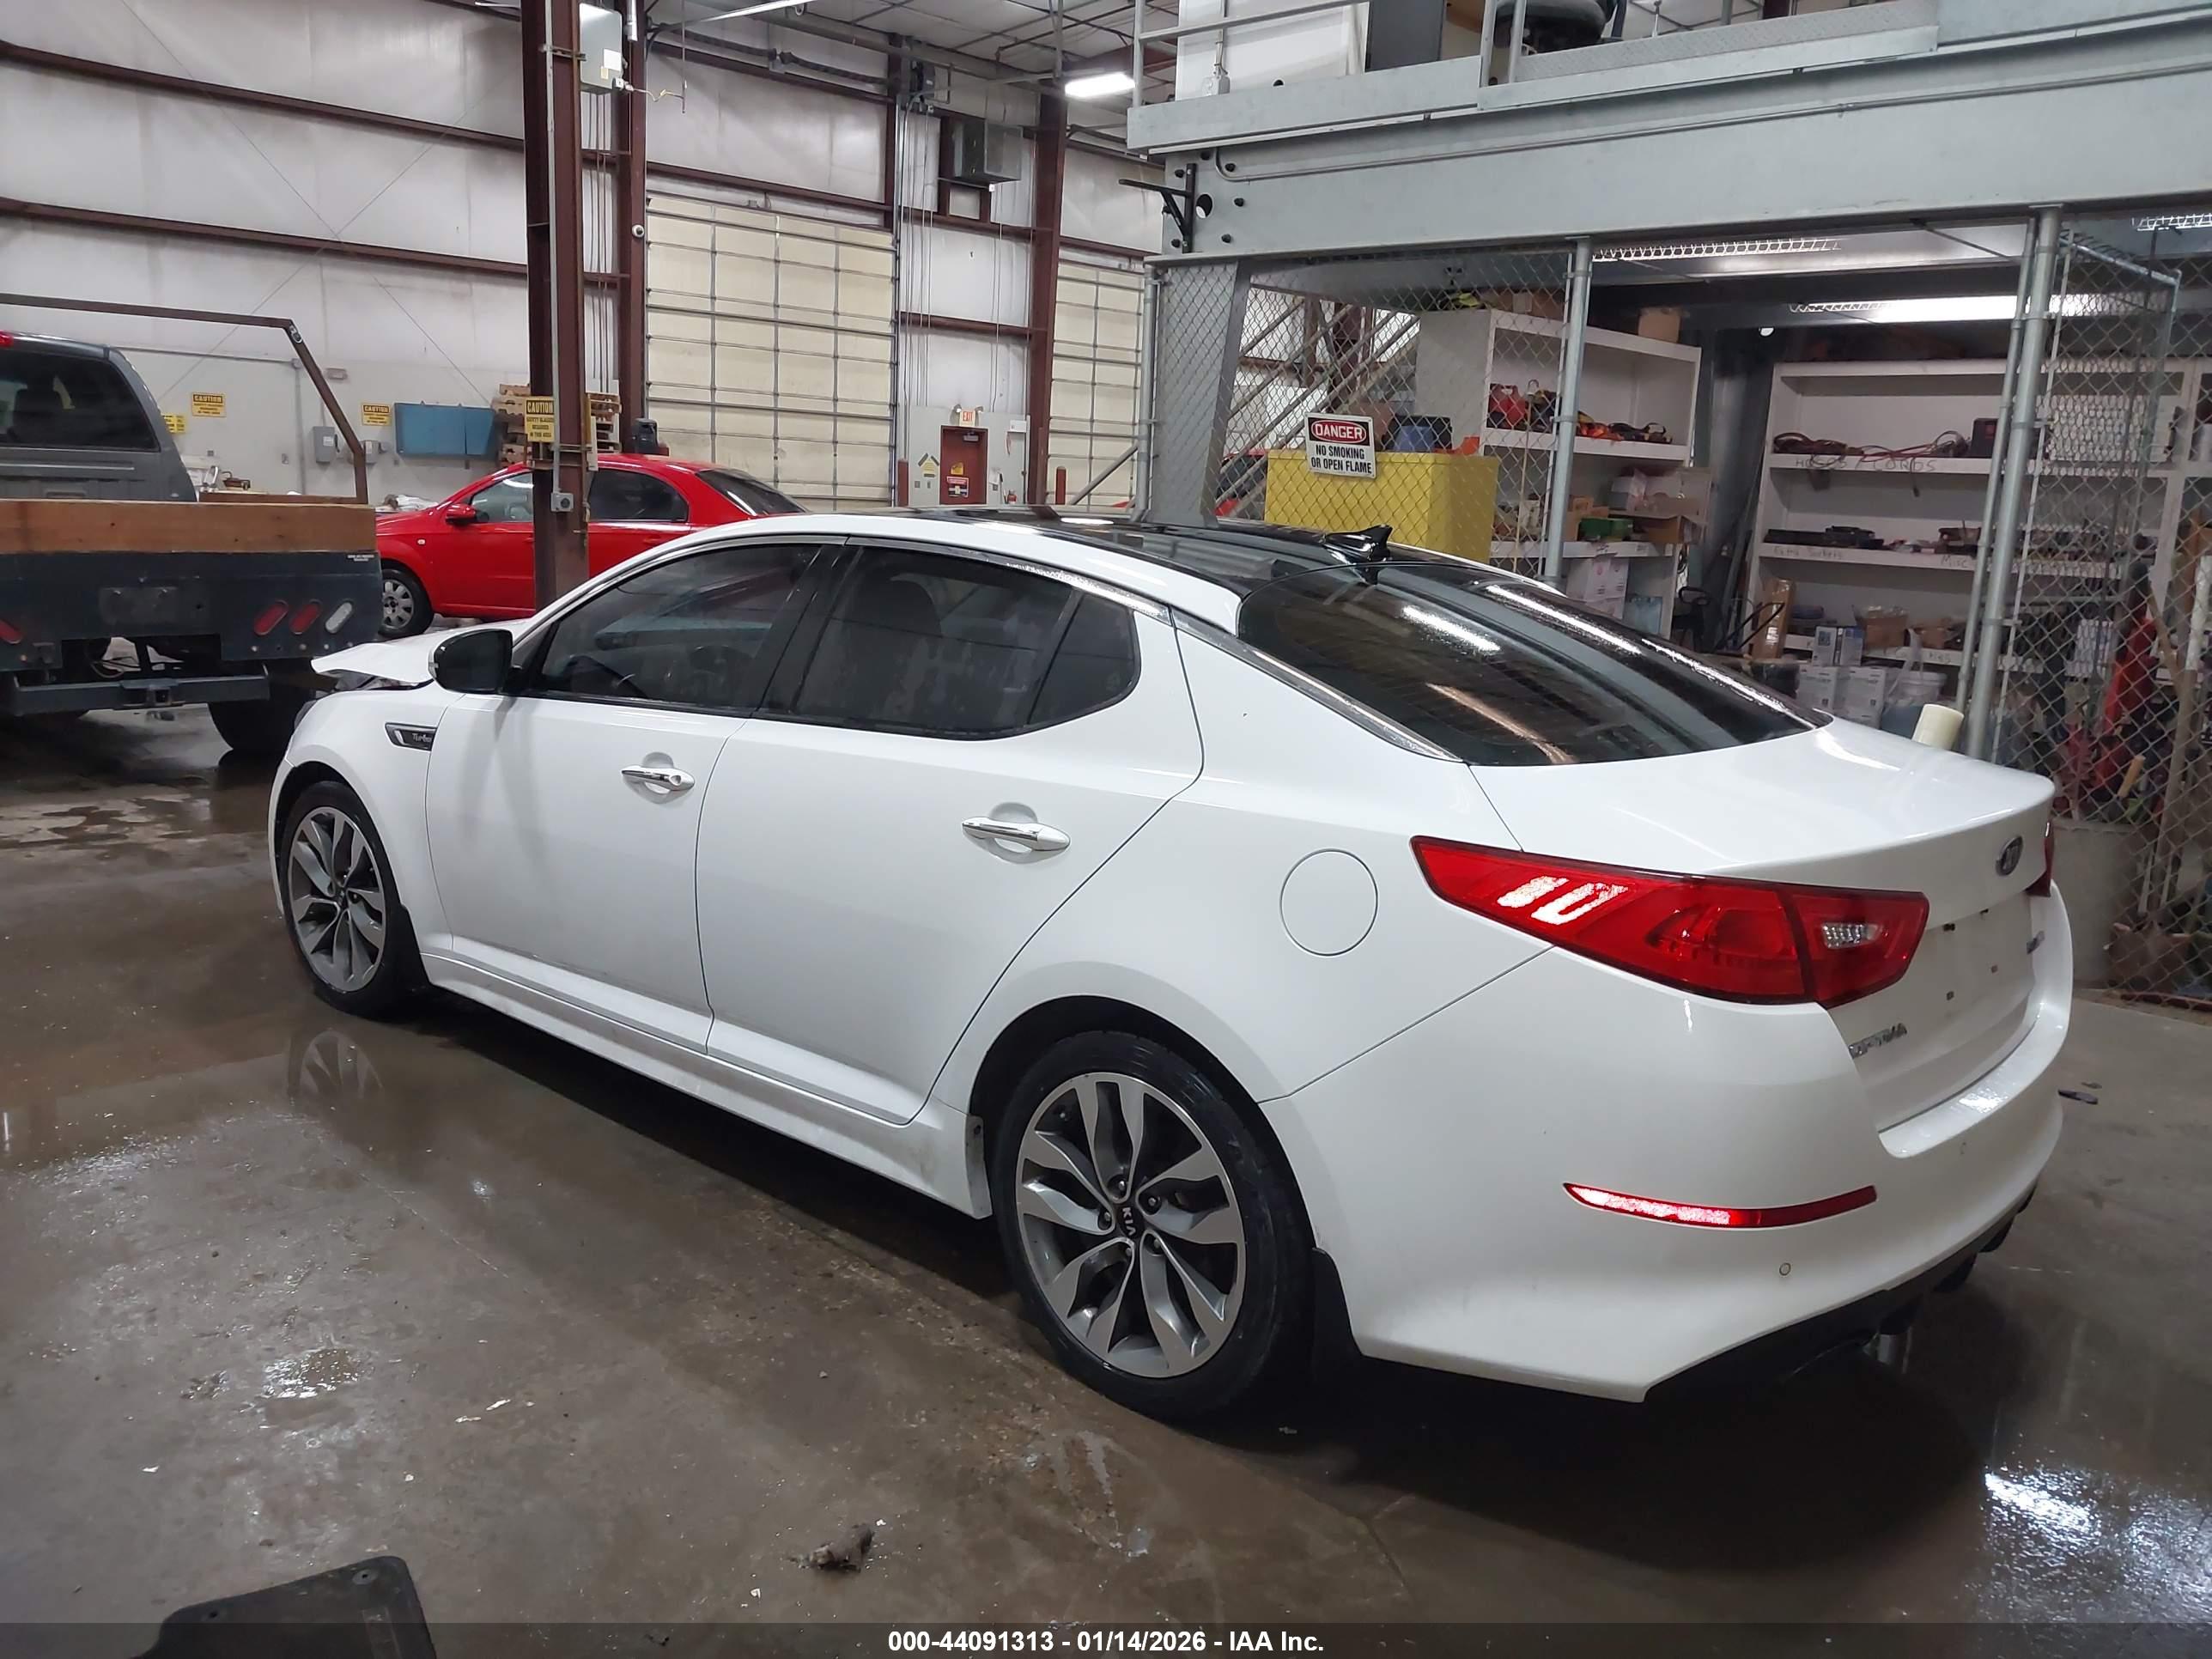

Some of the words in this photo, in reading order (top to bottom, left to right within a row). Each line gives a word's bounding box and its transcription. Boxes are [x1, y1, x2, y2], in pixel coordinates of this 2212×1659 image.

[527, 401, 554, 413] CAUTION
[1315, 423, 1363, 440] DANGER
[1316, 445, 1326, 456] NO
[1328, 446, 1364, 459] SMOKING
[1310, 457, 1321, 468] OR
[1323, 459, 1343, 471] OPEN
[1346, 460, 1372, 474] FLAME
[1122, 1207, 1136, 1236] KIA
